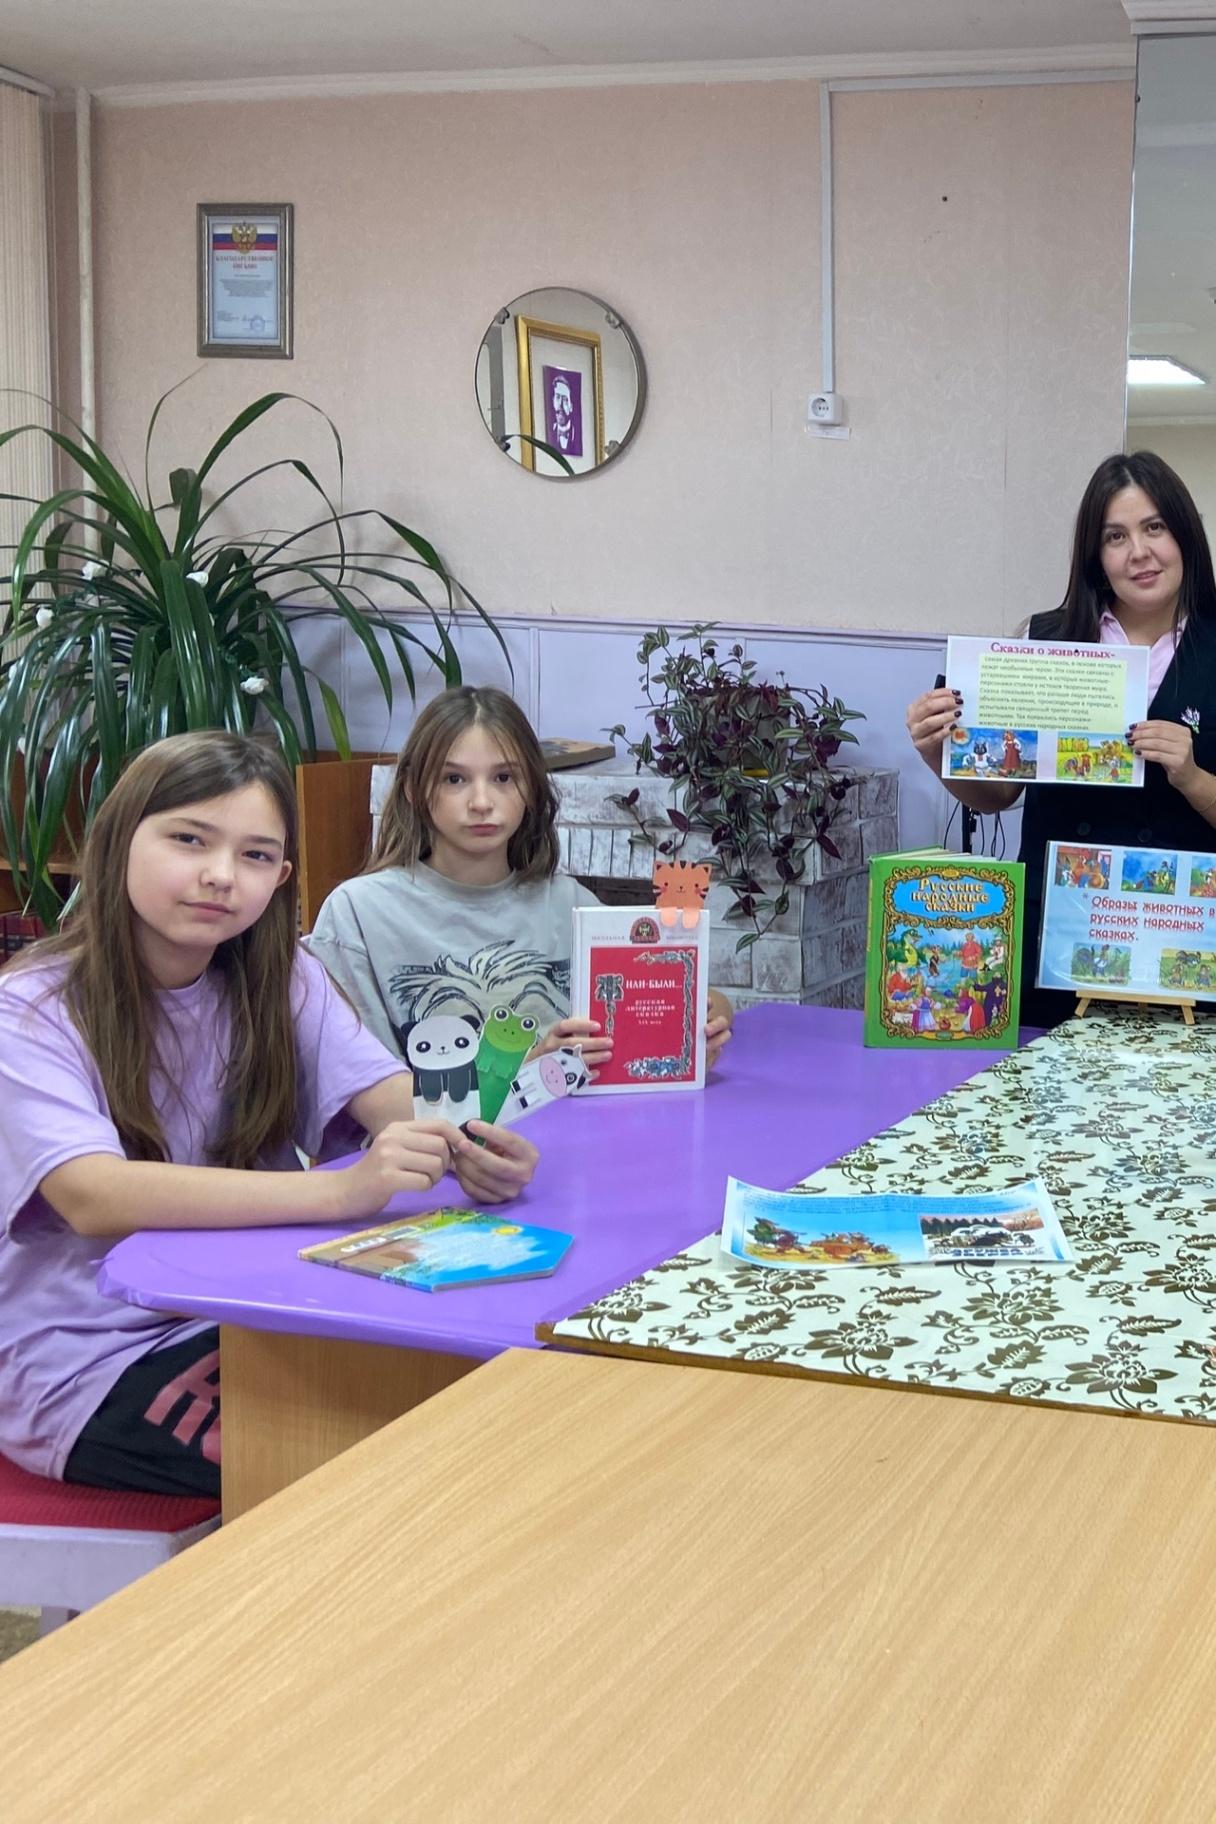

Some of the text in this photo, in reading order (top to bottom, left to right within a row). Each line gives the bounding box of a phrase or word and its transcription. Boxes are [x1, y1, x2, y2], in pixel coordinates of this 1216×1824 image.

[990, 641, 1035, 655] Сказки
[1037, 647, 1045, 655] о
[919, 878, 983, 894] Русские
[912, 891, 989, 904] народные
[925, 901, 975, 913] сказки
[1091, 895, 1138, 911] Образы
[1143, 902, 1205, 916] животных
[1090, 913, 1205, 932] русских народных
